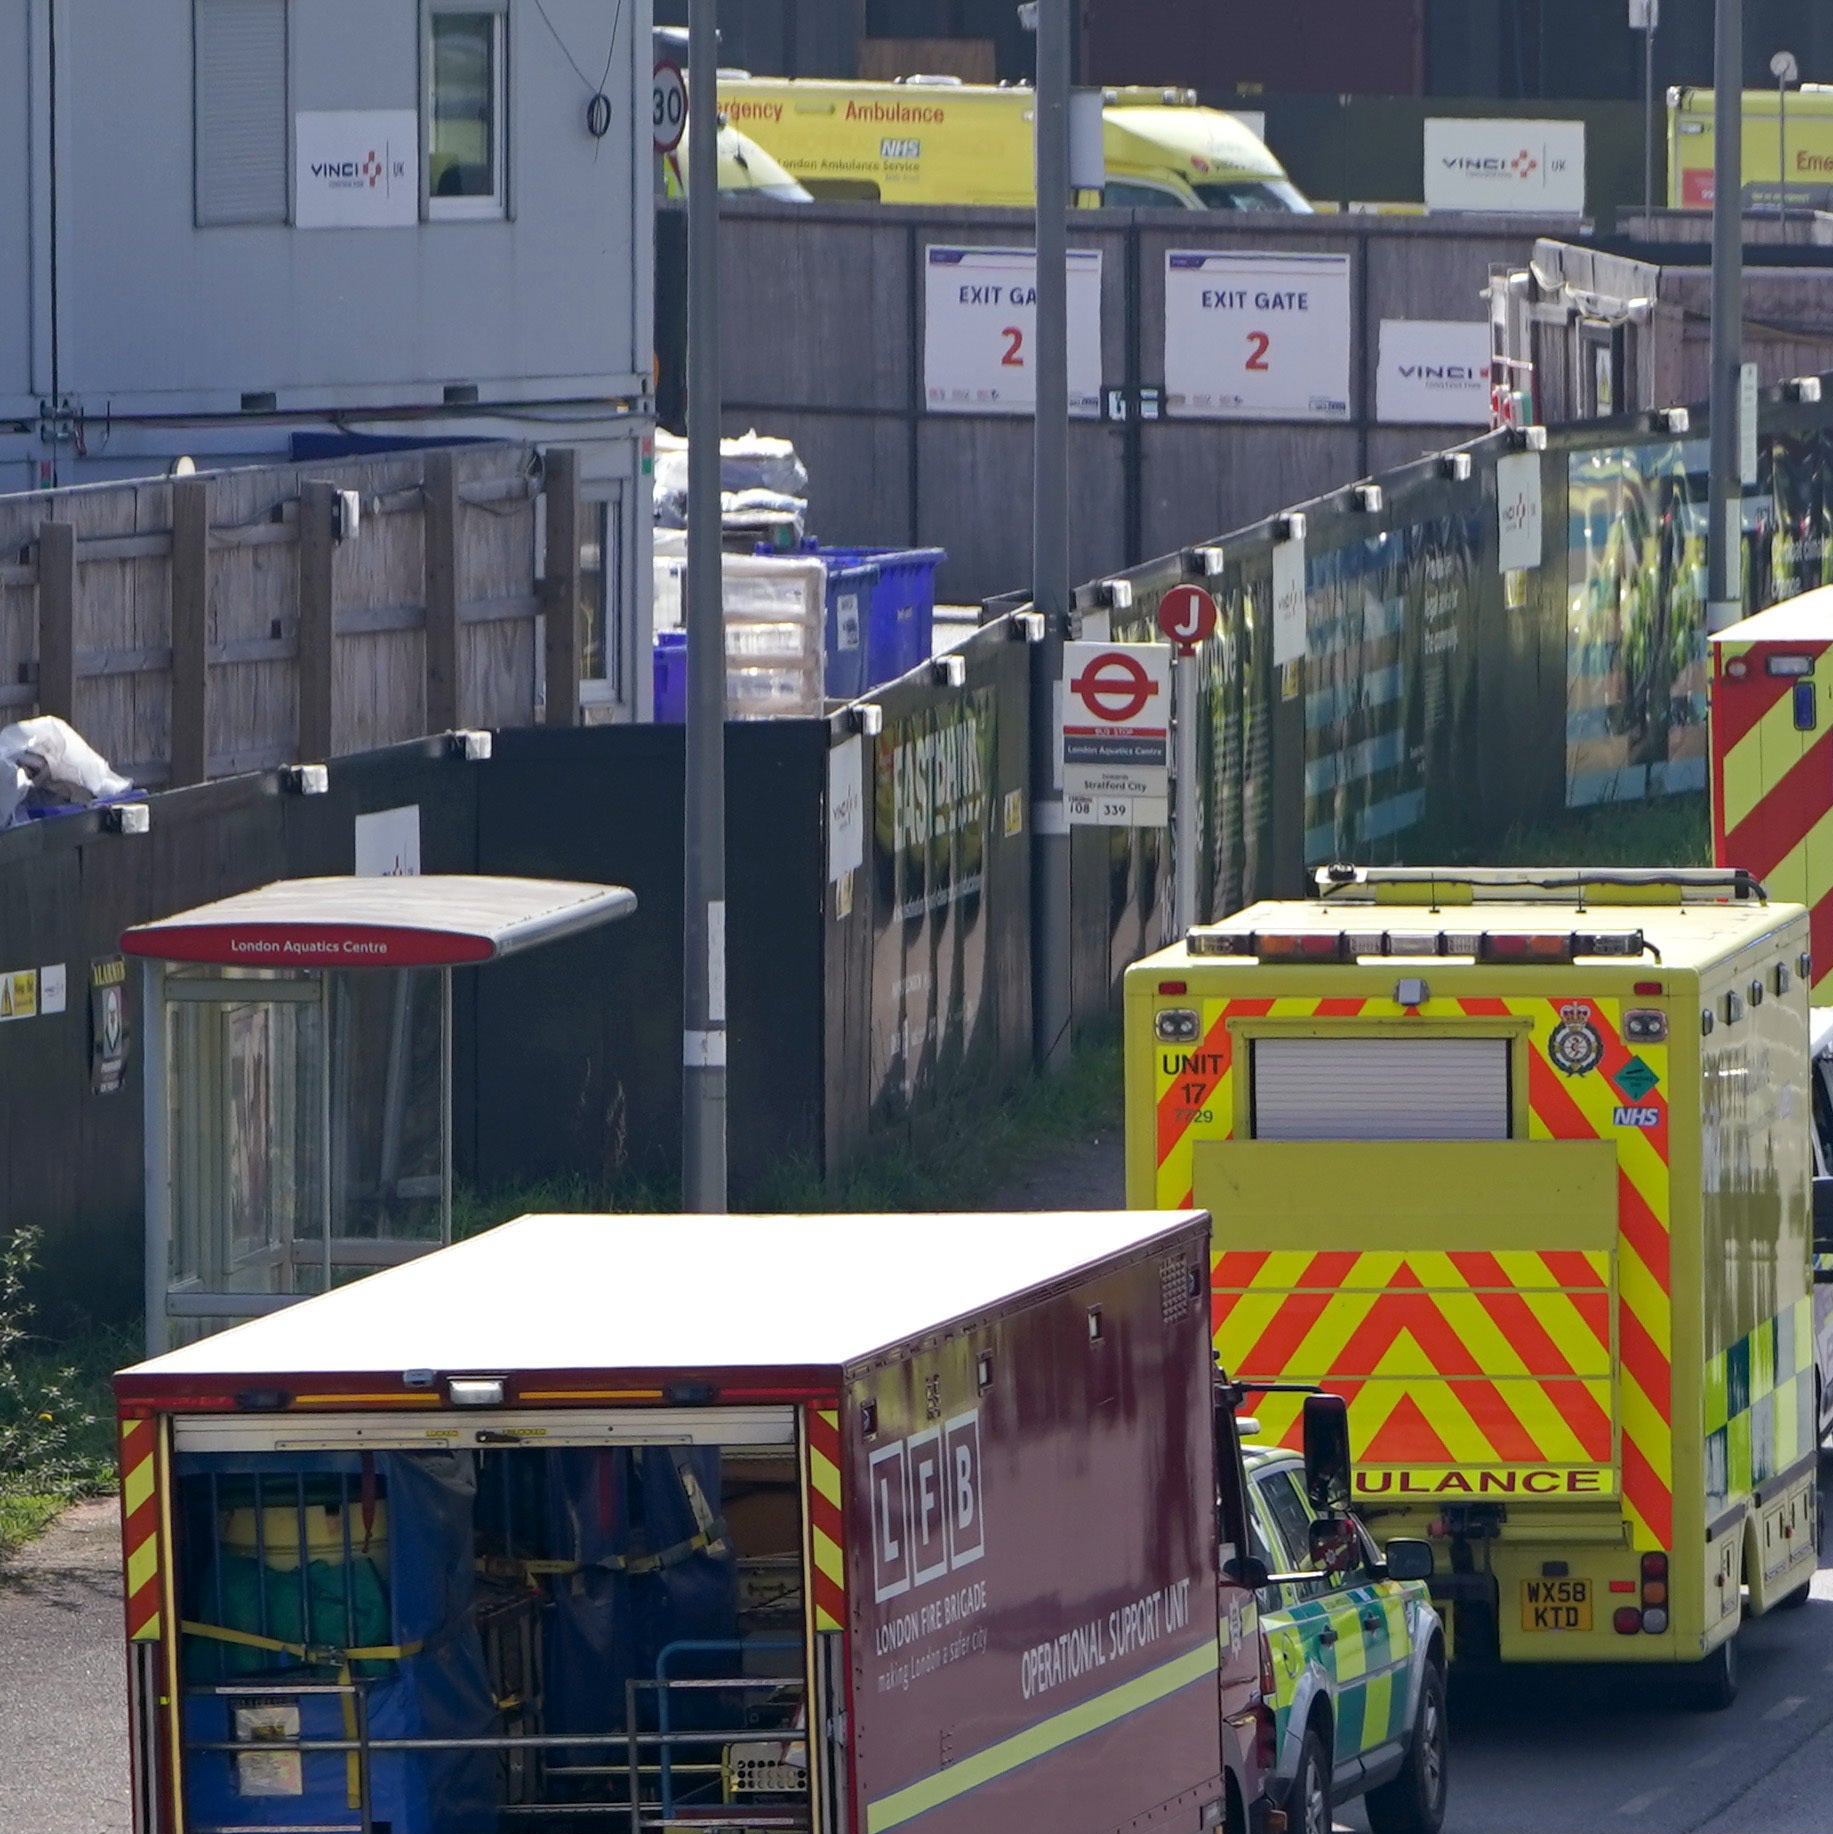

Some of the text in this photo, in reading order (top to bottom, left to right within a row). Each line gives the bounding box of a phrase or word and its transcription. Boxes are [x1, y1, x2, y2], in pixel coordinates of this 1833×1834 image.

[653, 88, 682, 125] 30
[716, 100, 945, 123] ergency Ambulance
[881, 139, 919, 157] NHS
[311, 162, 359, 178] VINCI
[393, 160, 405, 178] UK
[820, 159, 879, 171] Ambulance
[882, 161, 920, 171] Service
[1442, 157, 1506, 170] VINCI
[958, 285, 1037, 306] EXIT GA
[1202, 290, 1309, 311] EXIT GATE
[1001, 326, 1024, 367] 2
[1244, 330, 1270, 371] 2
[1398, 365, 1473, 379] VINCI
[1174, 595, 1199, 637] J
[1067, 745, 1161, 756] London Aquatics Centre
[1084, 780, 1147, 793] Stratford City
[1069, 803, 1090, 815] 108
[1103, 804, 1126, 815] 339
[231, 939, 388, 955] London Aquatics Centre
[1162, 1053, 1224, 1075] UNIT
[1182, 1083, 1207, 1104] 17
[1174, 1109, 1213, 1124] 7729
[1614, 1107, 1658, 1126] NHS
[1355, 1470, 1601, 1494] ULANCE
[880, 1443, 974, 1563] LFB
[1526, 1580, 1586, 1603] WX58
[875, 1580, 987, 1656] LONDON FIRE BRIGADE
[1532, 1604, 1579, 1629] KTD
[1021, 1577, 1191, 1700] OPERATIONAL SUPPORT UNIT
[877, 1662, 911, 1693] making
[911, 1646, 942, 1681] London
[949, 1634, 972, 1660] safer
[972, 1626, 988, 1655] city
